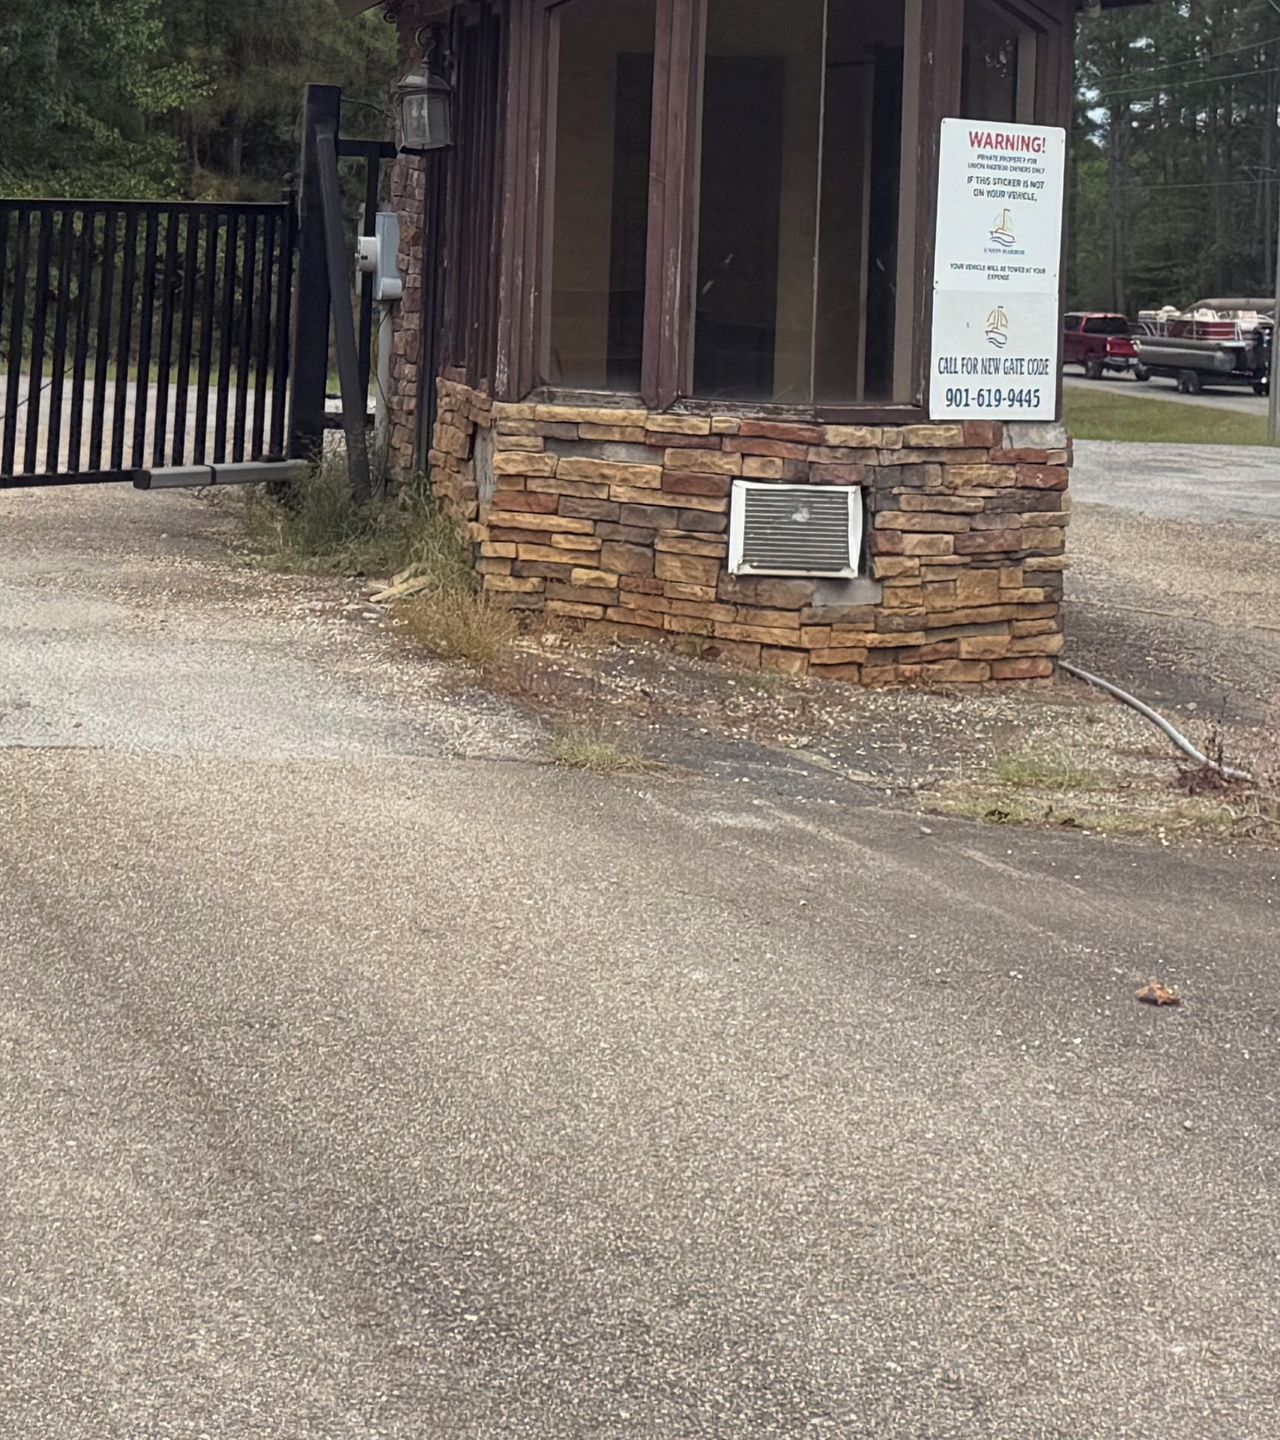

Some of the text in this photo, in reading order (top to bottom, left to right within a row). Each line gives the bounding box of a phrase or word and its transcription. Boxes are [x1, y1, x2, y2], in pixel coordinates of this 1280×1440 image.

[968, 130, 1046, 153] WARNING!
[966, 175, 1045, 189] IF THIS STICKER IS NOT
[973, 188, 985, 197] ON
[986, 189, 1006, 199] YOUR
[965, 263, 986, 271] VEHICLE
[986, 264, 999, 272] WILL
[937, 356, 1050, 376] CALL FOR NEW GATE CODE
[945, 387, 1041, 408] 901-619-9445
